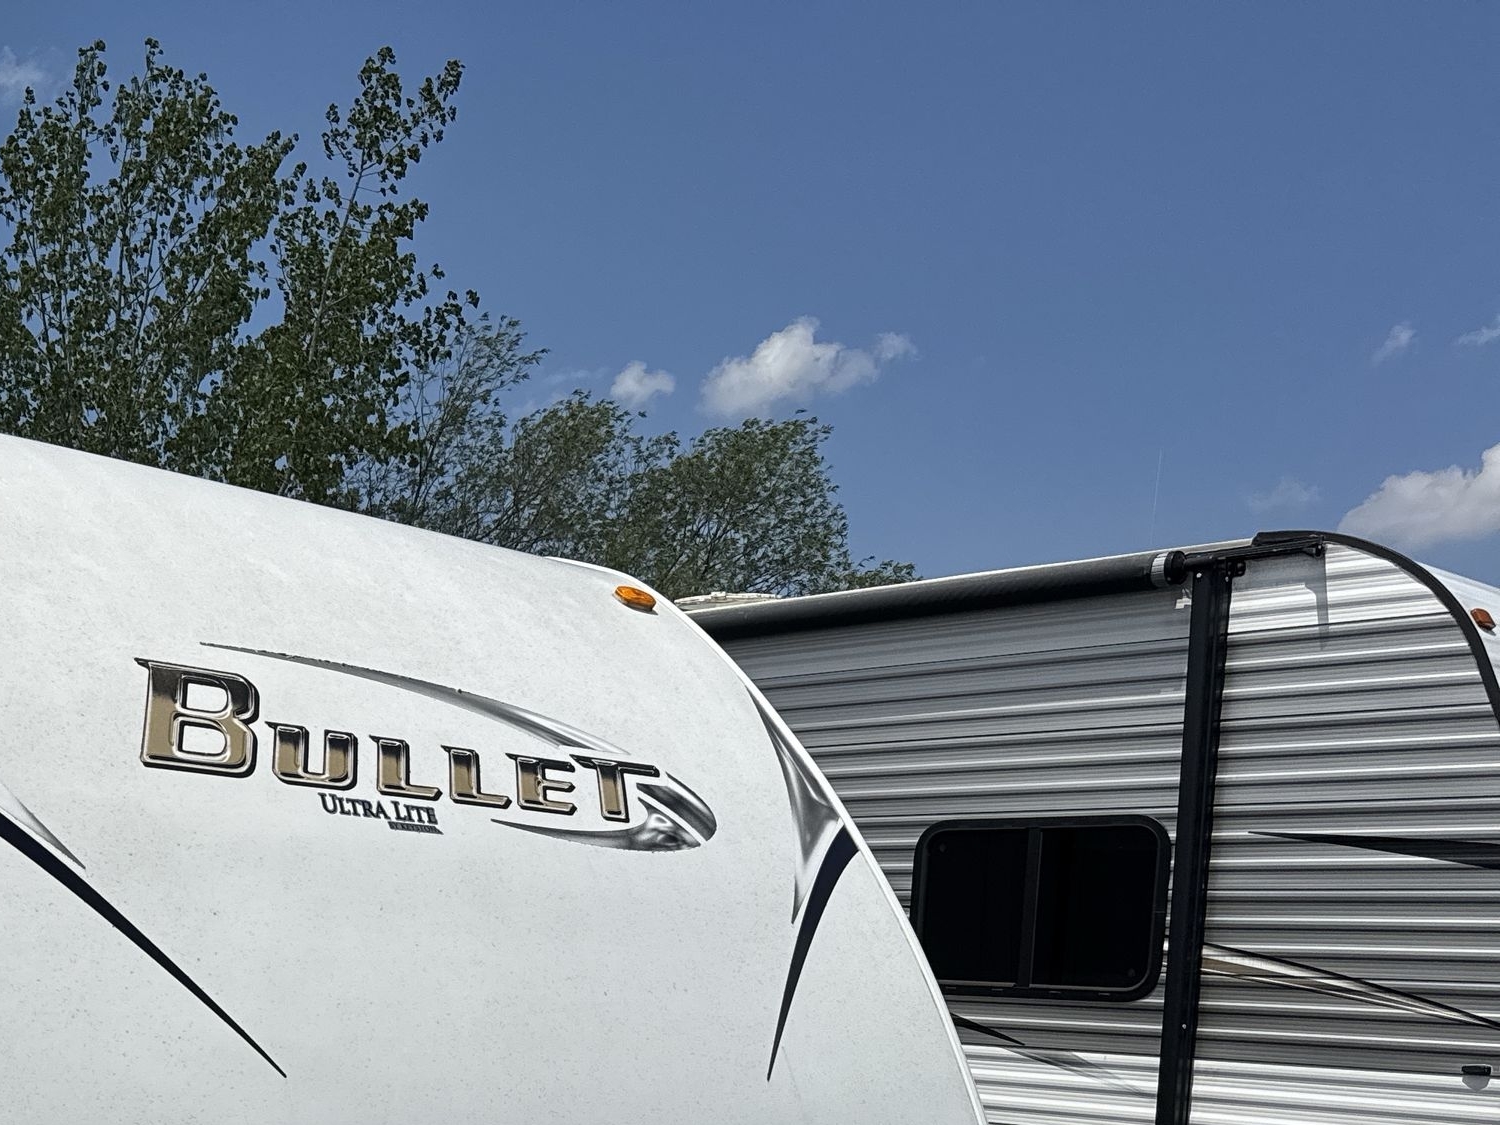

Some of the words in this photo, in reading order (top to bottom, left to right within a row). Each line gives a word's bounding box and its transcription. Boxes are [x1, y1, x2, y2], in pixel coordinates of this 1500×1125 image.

[133, 656, 660, 823] BULLET
[317, 792, 391, 820] ULTRA
[390, 800, 439, 825] LITE
